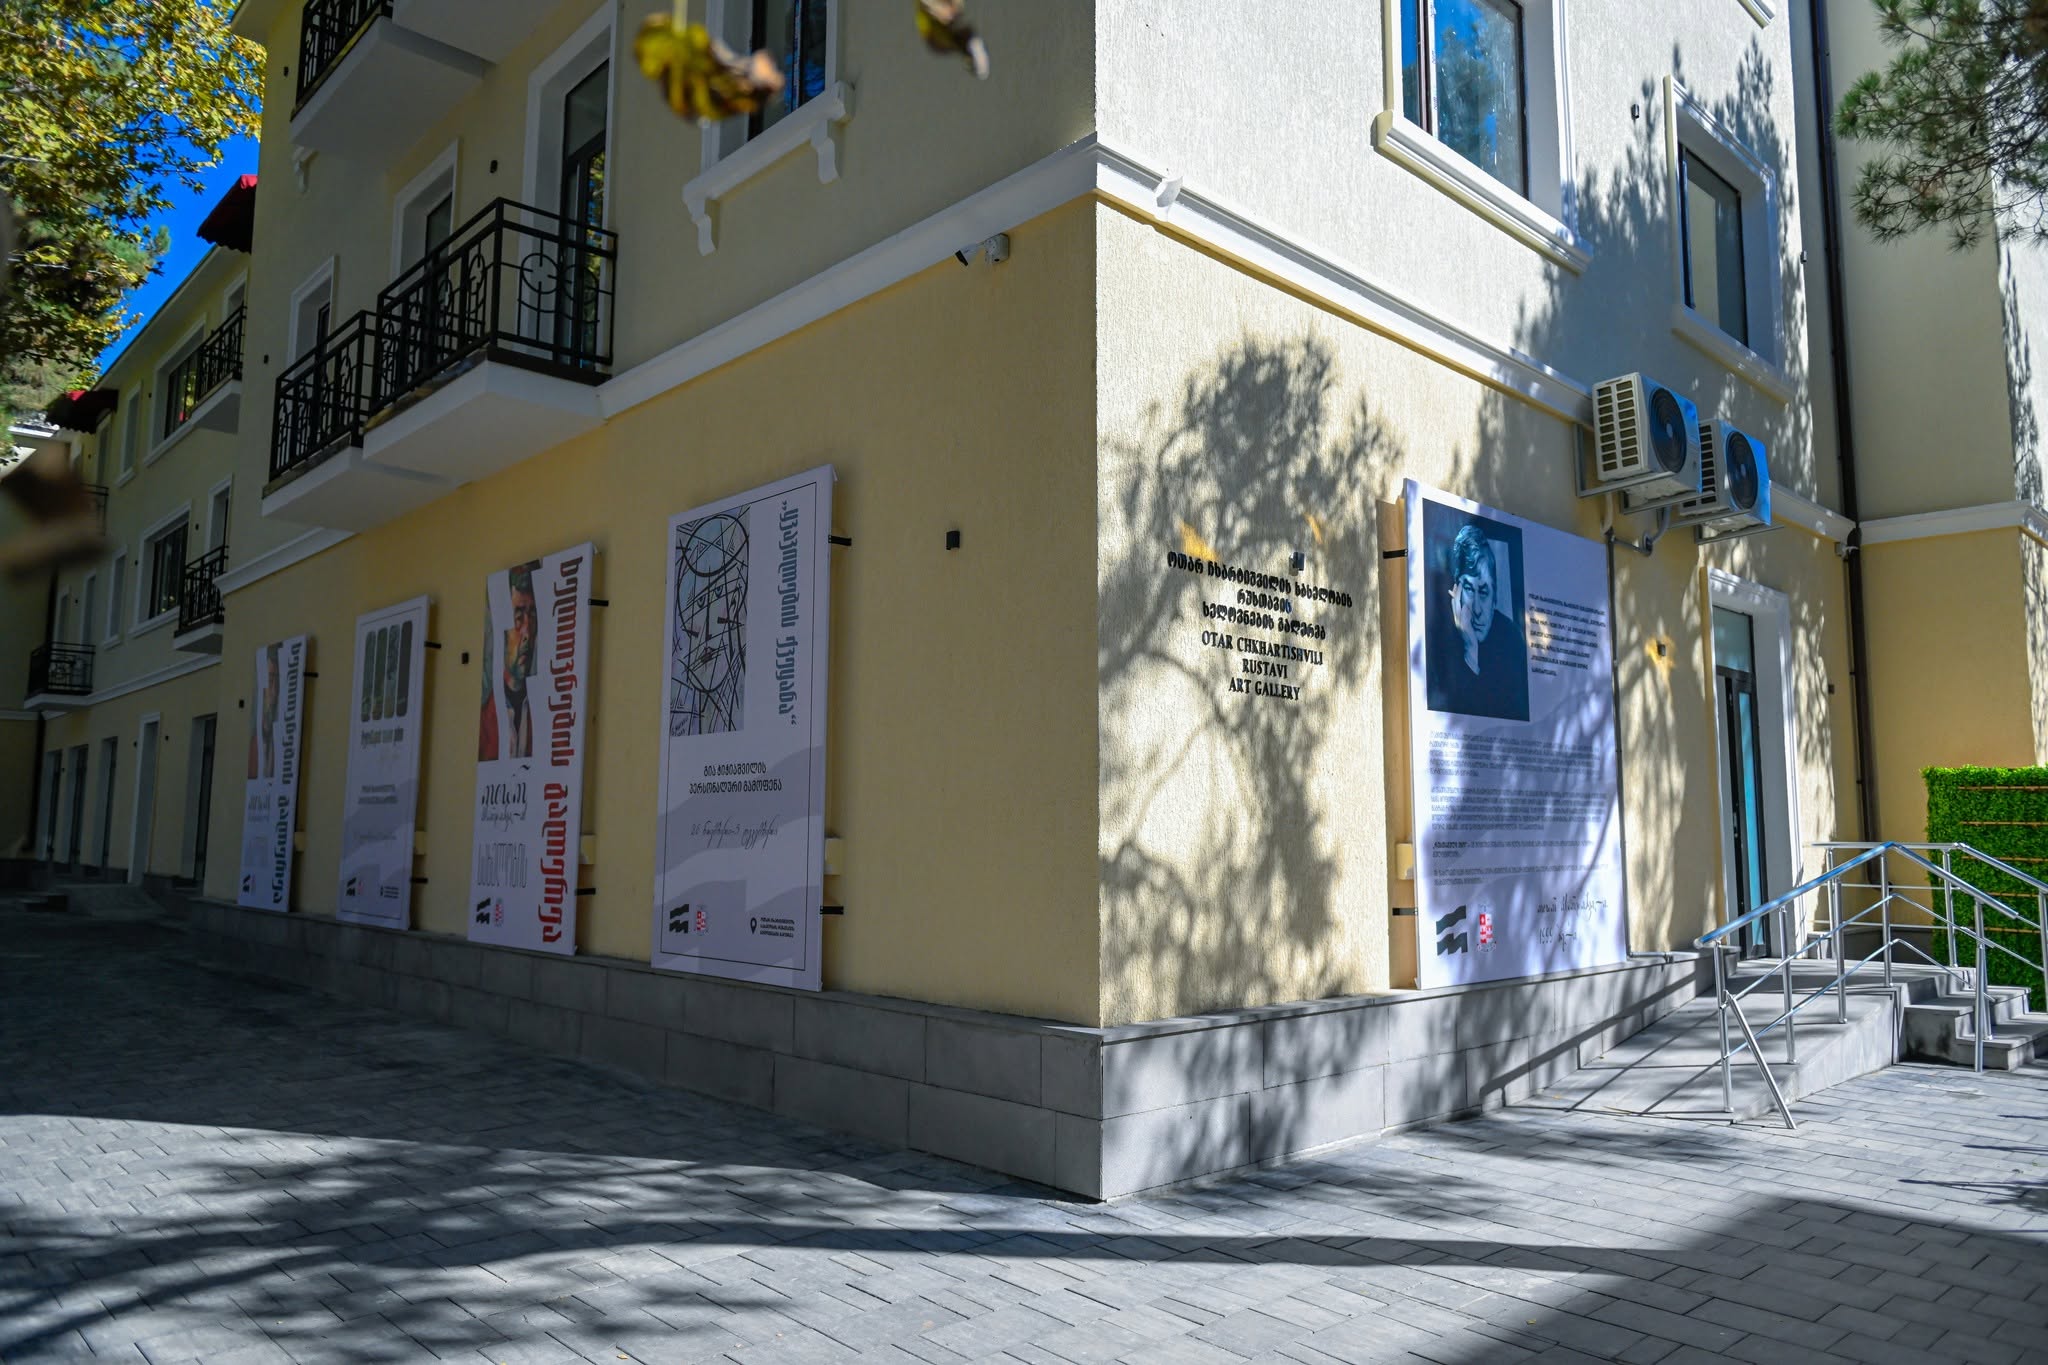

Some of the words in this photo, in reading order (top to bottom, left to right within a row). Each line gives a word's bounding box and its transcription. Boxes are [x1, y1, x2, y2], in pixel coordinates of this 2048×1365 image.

[1167, 551, 1204, 574] ოთარ
[1207, 560, 1292, 594] ჩხარტიშვილის
[1295, 582, 1353, 608] სახელობის
[1236, 588, 1293, 614] რუსთავის
[1202, 601, 1275, 631] ხელოვნების
[1278, 617, 1326, 640] გალერეა
[548, 556, 584, 767] ხელოვნების
[1201, 630, 1233, 650] OTAR
[1236, 636, 1323, 666] CHKHARTISHVILI
[1241, 658, 1288, 679] RUSTAVI
[1228, 677, 1252, 694] ART
[1254, 681, 1301, 700] GALLERY
[538, 783, 568, 943] გალერეა
